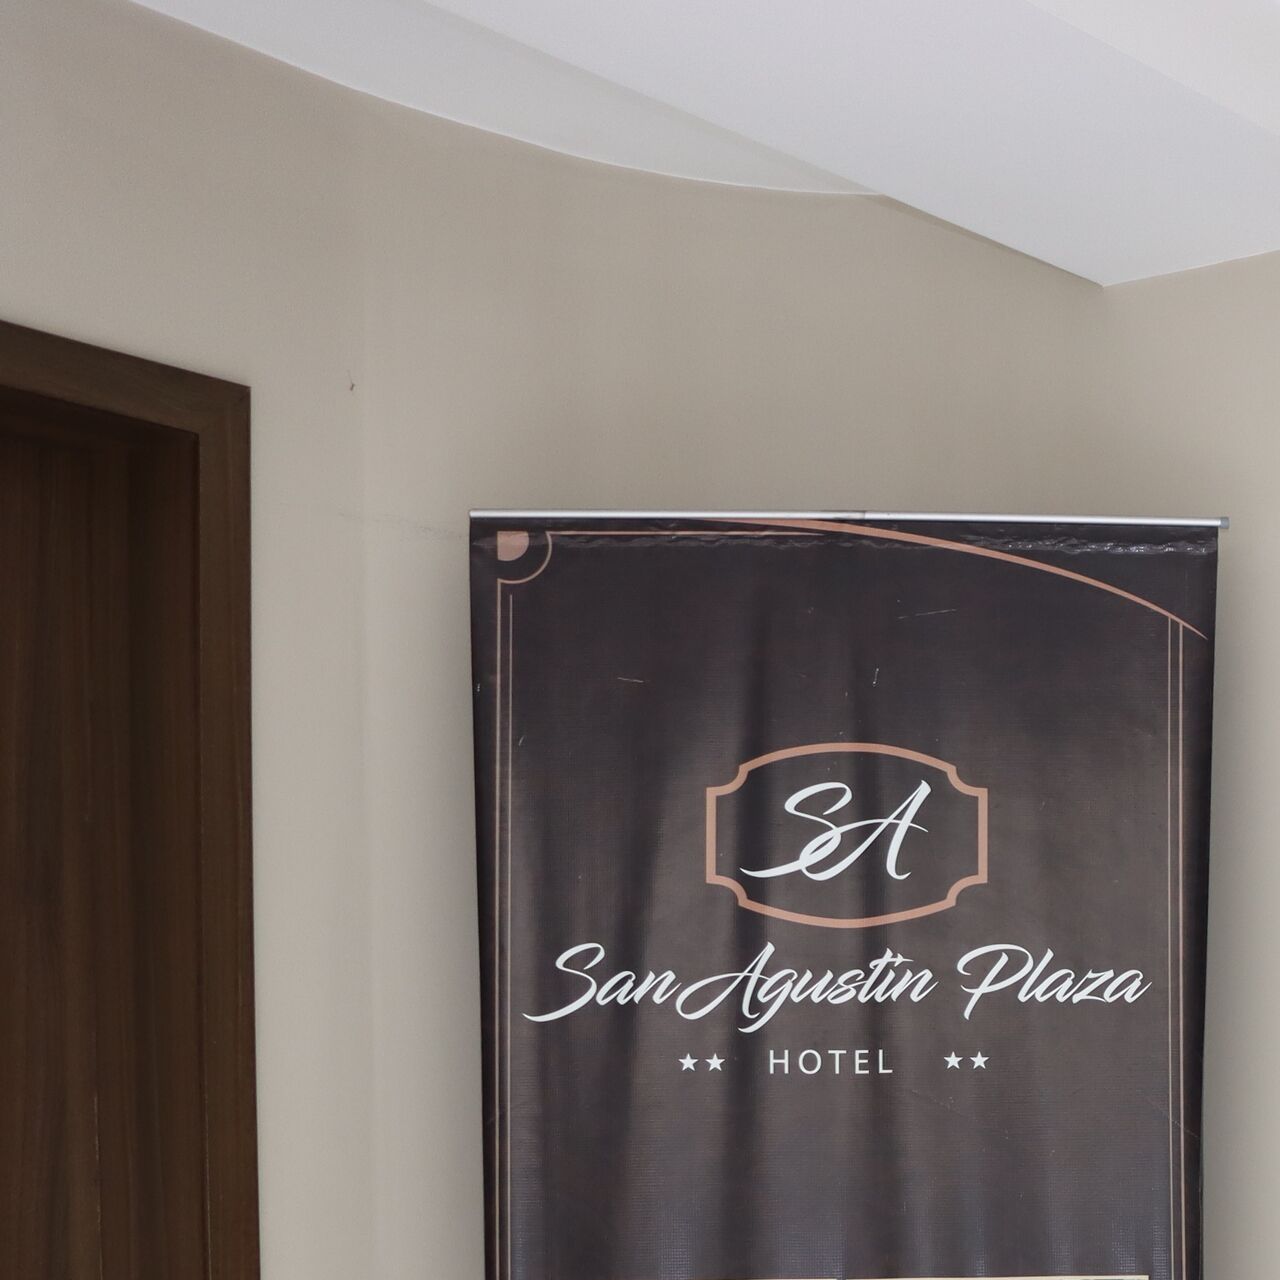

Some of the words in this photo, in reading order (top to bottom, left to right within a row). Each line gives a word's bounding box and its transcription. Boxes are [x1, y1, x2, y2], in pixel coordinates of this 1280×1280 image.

[740, 779, 929, 882] SA
[522, 942, 683, 1022] San
[955, 943, 1153, 1020] Plaza
[768, 1048, 894, 1075] HOTEL
